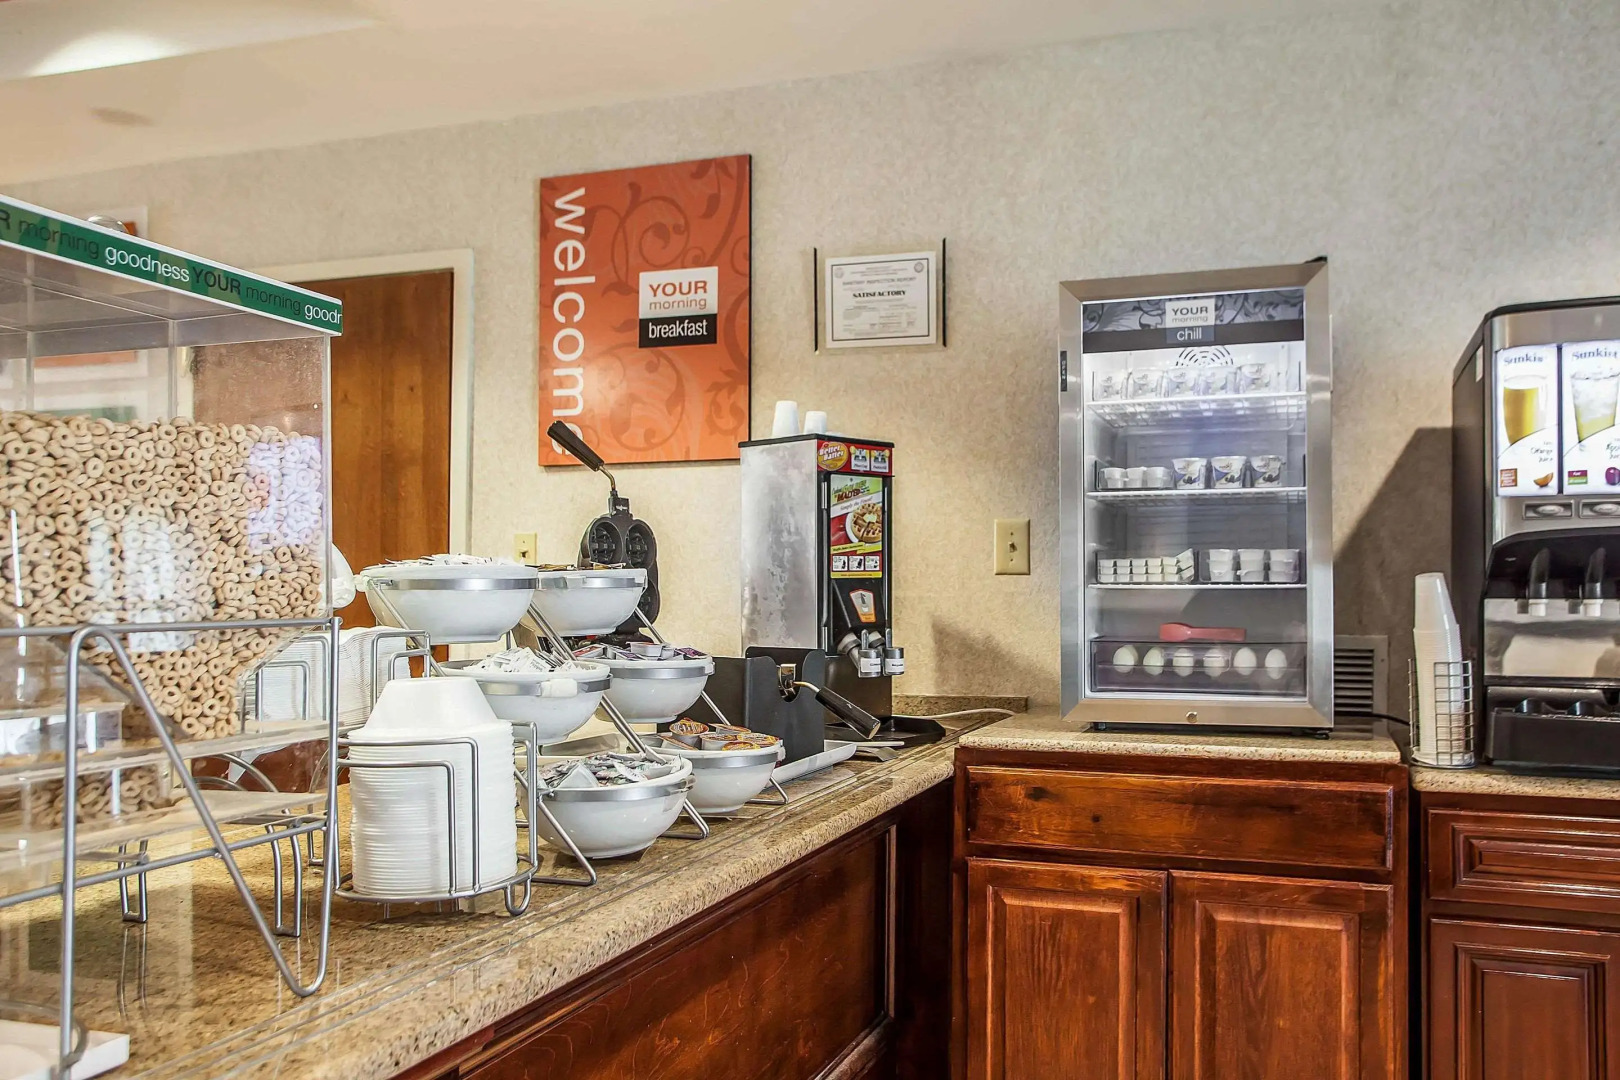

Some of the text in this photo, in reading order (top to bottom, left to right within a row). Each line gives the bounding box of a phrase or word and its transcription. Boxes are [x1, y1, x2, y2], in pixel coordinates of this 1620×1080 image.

[18, 220, 99, 260] morning
[105, 246, 190, 282] goodness
[192, 266, 241, 295] YOUR
[246, 286, 301, 315] morning
[649, 280, 708, 297] YOUR
[852, 290, 906, 298] SATISFACTORY
[649, 297, 707, 310] morning
[1171, 306, 1208, 316] YOUR
[1172, 315, 1208, 323] morning
[648, 319, 708, 339] breakfast
[1176, 327, 1202, 341] chill
